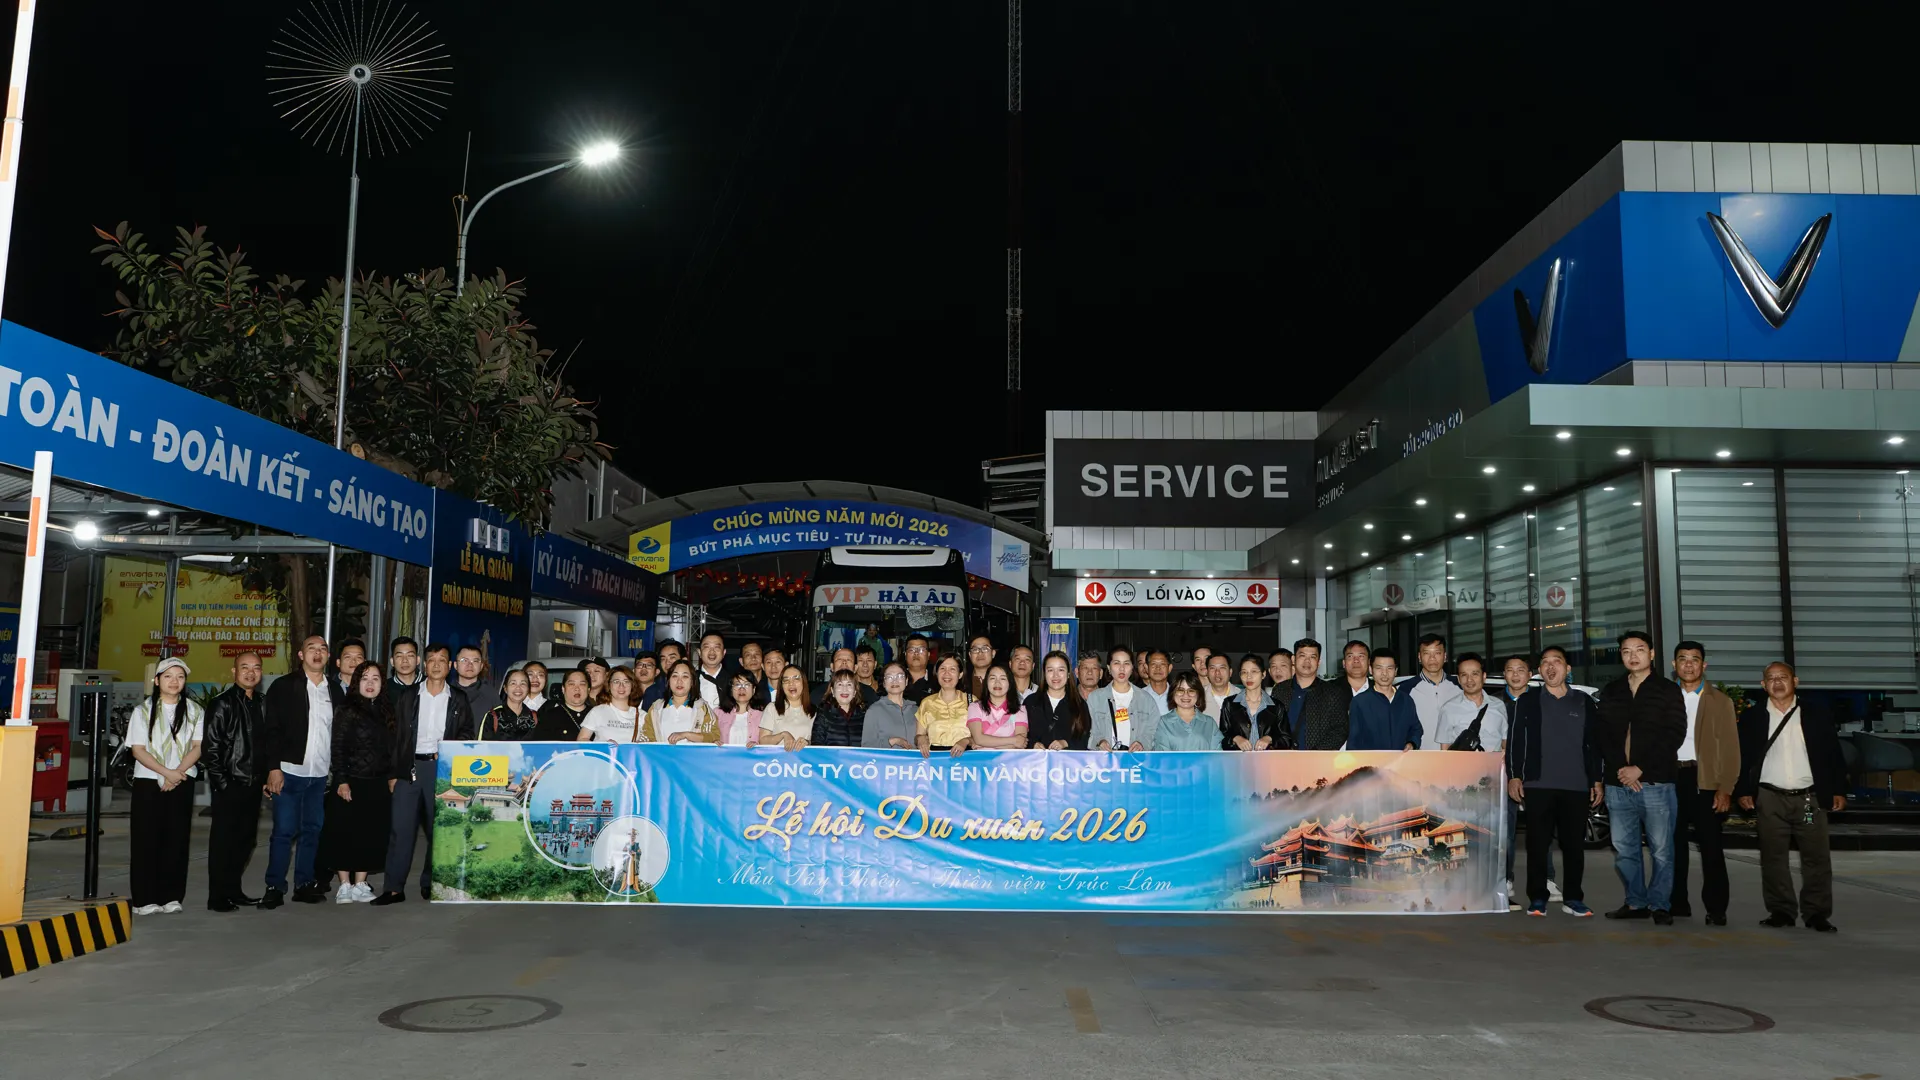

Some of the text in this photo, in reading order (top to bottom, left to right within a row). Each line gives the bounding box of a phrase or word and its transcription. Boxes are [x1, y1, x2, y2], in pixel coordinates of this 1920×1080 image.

[0, 366, 119, 447] TOÀN
[152, 418, 252, 486] ĐOÀN
[258, 451, 310, 502] KẾT
[328, 475, 386, 527] SÁNG
[391, 502, 427, 544] TẠO
[1080, 462, 1289, 499] SERVICE
[712, 507, 949, 537] CHÚC MỪNG NĂM MỚI 2026
[688, 541, 718, 557] BỨT
[723, 533, 753, 550] PHÁ
[758, 532, 791, 547] MỤC
[796, 529, 829, 543] TIÊU
[845, 532, 865, 546] TỰ
[869, 534, 893, 545] TIN
[460, 541, 513, 582] LỄ RA QUÂN
[537, 544, 554, 577] KỶ
[555, 556, 584, 589] LUẬT
[591, 567, 621, 596] TRÁCH
[442, 581, 462, 606] CHÀO
[822, 585, 956, 605] VIP HẢI ÂU
[1116, 589, 1134, 597] 3.5m
[1146, 584, 1205, 601] LỐI VÀO
[1224, 588, 1230, 596] 5
[174, 615, 194, 626] HÀO
[223, 616, 240, 626] CÁC
[235, 631, 250, 642] TẠO
[628, 638, 643, 649] AN
[752, 758, 1144, 786] CÔNG TY CỔ PHẦN ÉN VÀNG QUỐC TẾ
[743, 791, 1149, 852] Lễ hội Du xuân 2026
[717, 862, 776, 886] Mẫu
[785, 862, 830, 896] Tây
[840, 864, 901, 888] Thiên
[932, 865, 994, 891] Thiền
[1003, 873, 1048, 895] viện
[1057, 869, 1109, 891] Trúc
[1118, 867, 1173, 892] Lâm
